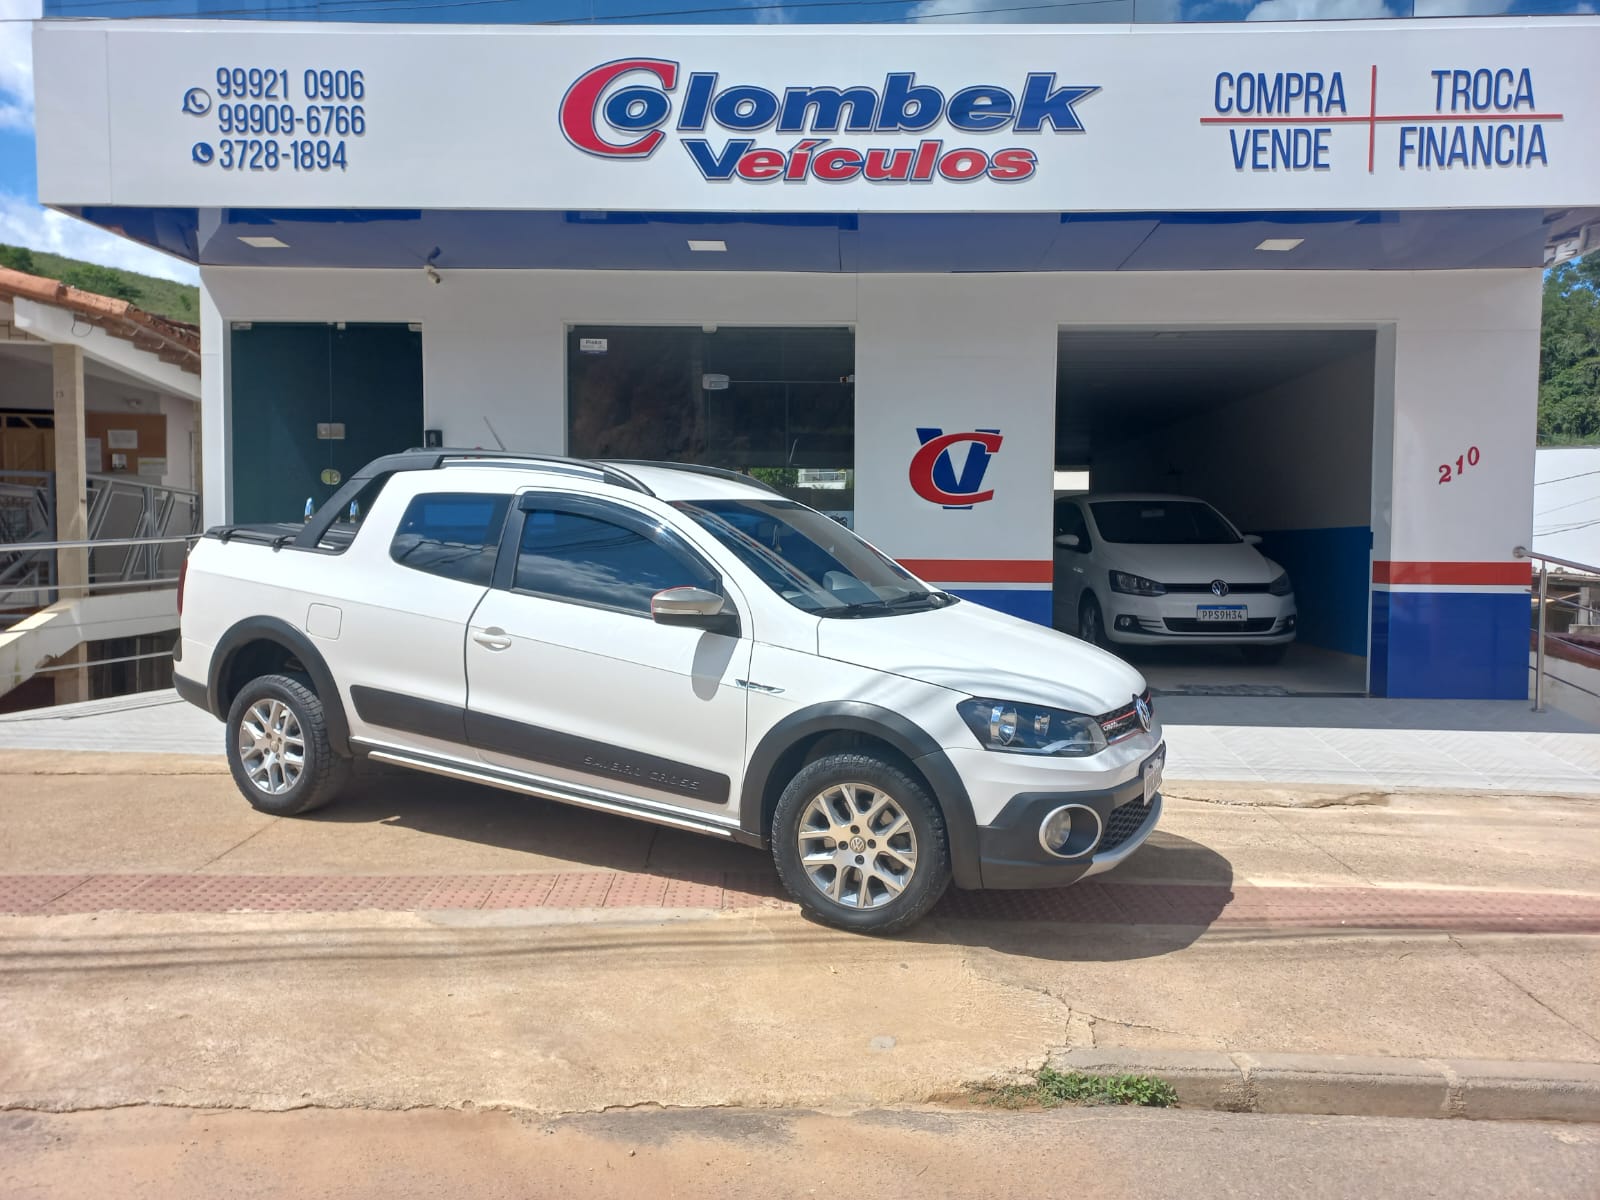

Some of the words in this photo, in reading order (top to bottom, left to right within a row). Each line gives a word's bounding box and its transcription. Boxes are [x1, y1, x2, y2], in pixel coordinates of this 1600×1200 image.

[216, 67, 289, 99] 99921
[303, 69, 365, 100] 0906
[1214, 71, 1347, 114] COMPRA
[1430, 67, 1536, 112] TROCA
[218, 103, 366, 136] 99909-6766
[558, 57, 1103, 159] Colombek
[219, 139, 347, 171] 3728-1894
[679, 137, 1039, 183] Veículos
[1228, 127, 1332, 171] VENDE
[1399, 123, 1549, 168] FINANCIA
[1438, 446, 1480, 485] 210
[1201, 610, 1243, 620] PPS9H34
